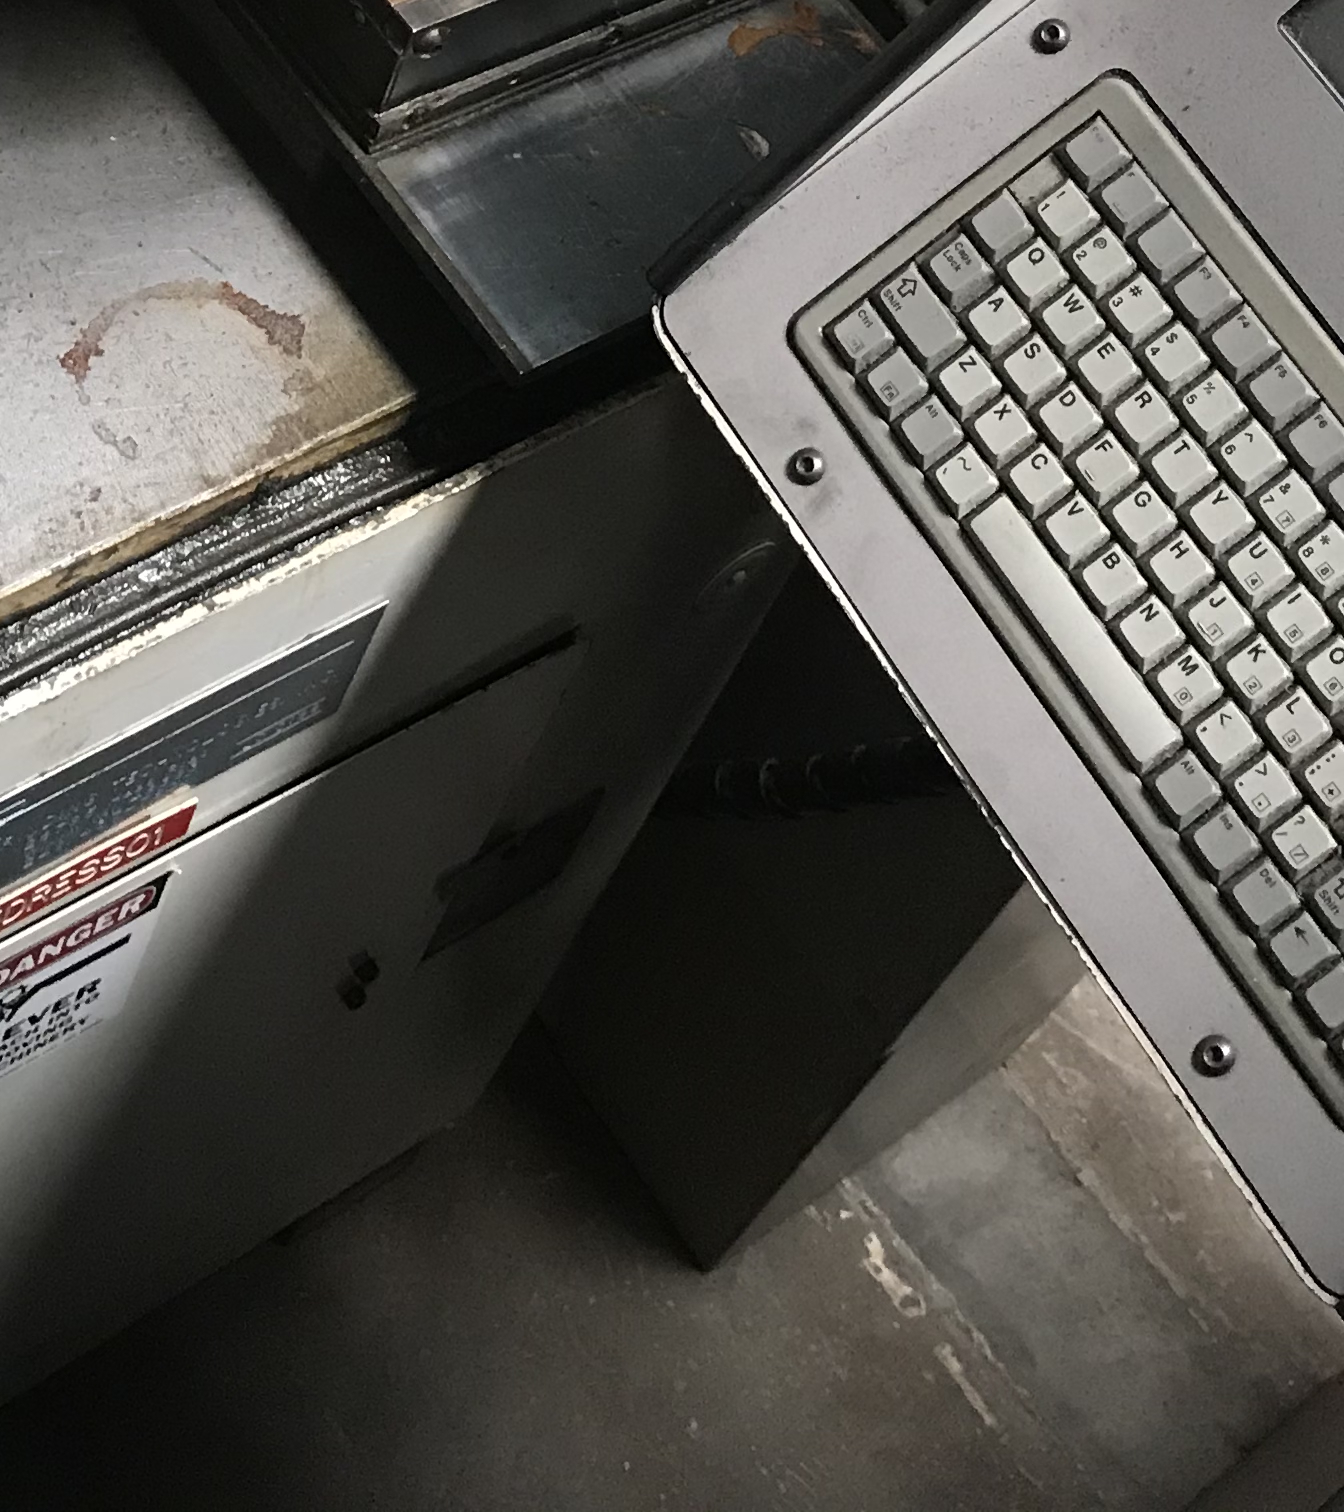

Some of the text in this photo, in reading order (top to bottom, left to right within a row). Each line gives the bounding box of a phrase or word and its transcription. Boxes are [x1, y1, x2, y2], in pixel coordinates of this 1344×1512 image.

[1040, 203, 1051, 212] 1
[943, 249, 962, 272] Lock
[1028, 247, 1045, 266] Q
[1076, 249, 1088, 261] 2
[884, 289, 902, 312] Shift
[988, 297, 1004, 312] A
[1063, 292, 1084, 314] W
[1112, 297, 1124, 308] 3
[858, 309, 873, 328] Ctrl
[1024, 343, 1041, 359] S
[1097, 342, 1116, 359] E
[1150, 346, 1161, 356] 4
[959, 355, 977, 373] Z
[1059, 391, 1076, 407] D
[1135, 391, 1152, 409] R
[1186, 394, 1198, 405] 5
[993, 404, 1011, 421] X
[1095, 439, 1114, 452] F
[1174, 440, 1191, 455] T
[1225, 445, 1236, 455] 6
[1031, 453, 1048, 470] C
[1135, 491, 1152, 508] G
[1212, 490, 1229, 505] Y
[1263, 494, 1275, 503] 7
[1068, 501, 1085, 516] V
[1169, 540, 1189, 559] H
[1249, 541, 1268, 559] U
[1302, 546, 1315, 558] 8
[1102, 551, 1121, 569] B
[1209, 596, 1227, 608] J
[1140, 603, 1160, 622] N
[1247, 643, 1266, 662] K
[1178, 655, 1199, 677] M
[1286, 696, 1301, 715] L
[1318, 889, 1340, 915] Shift
